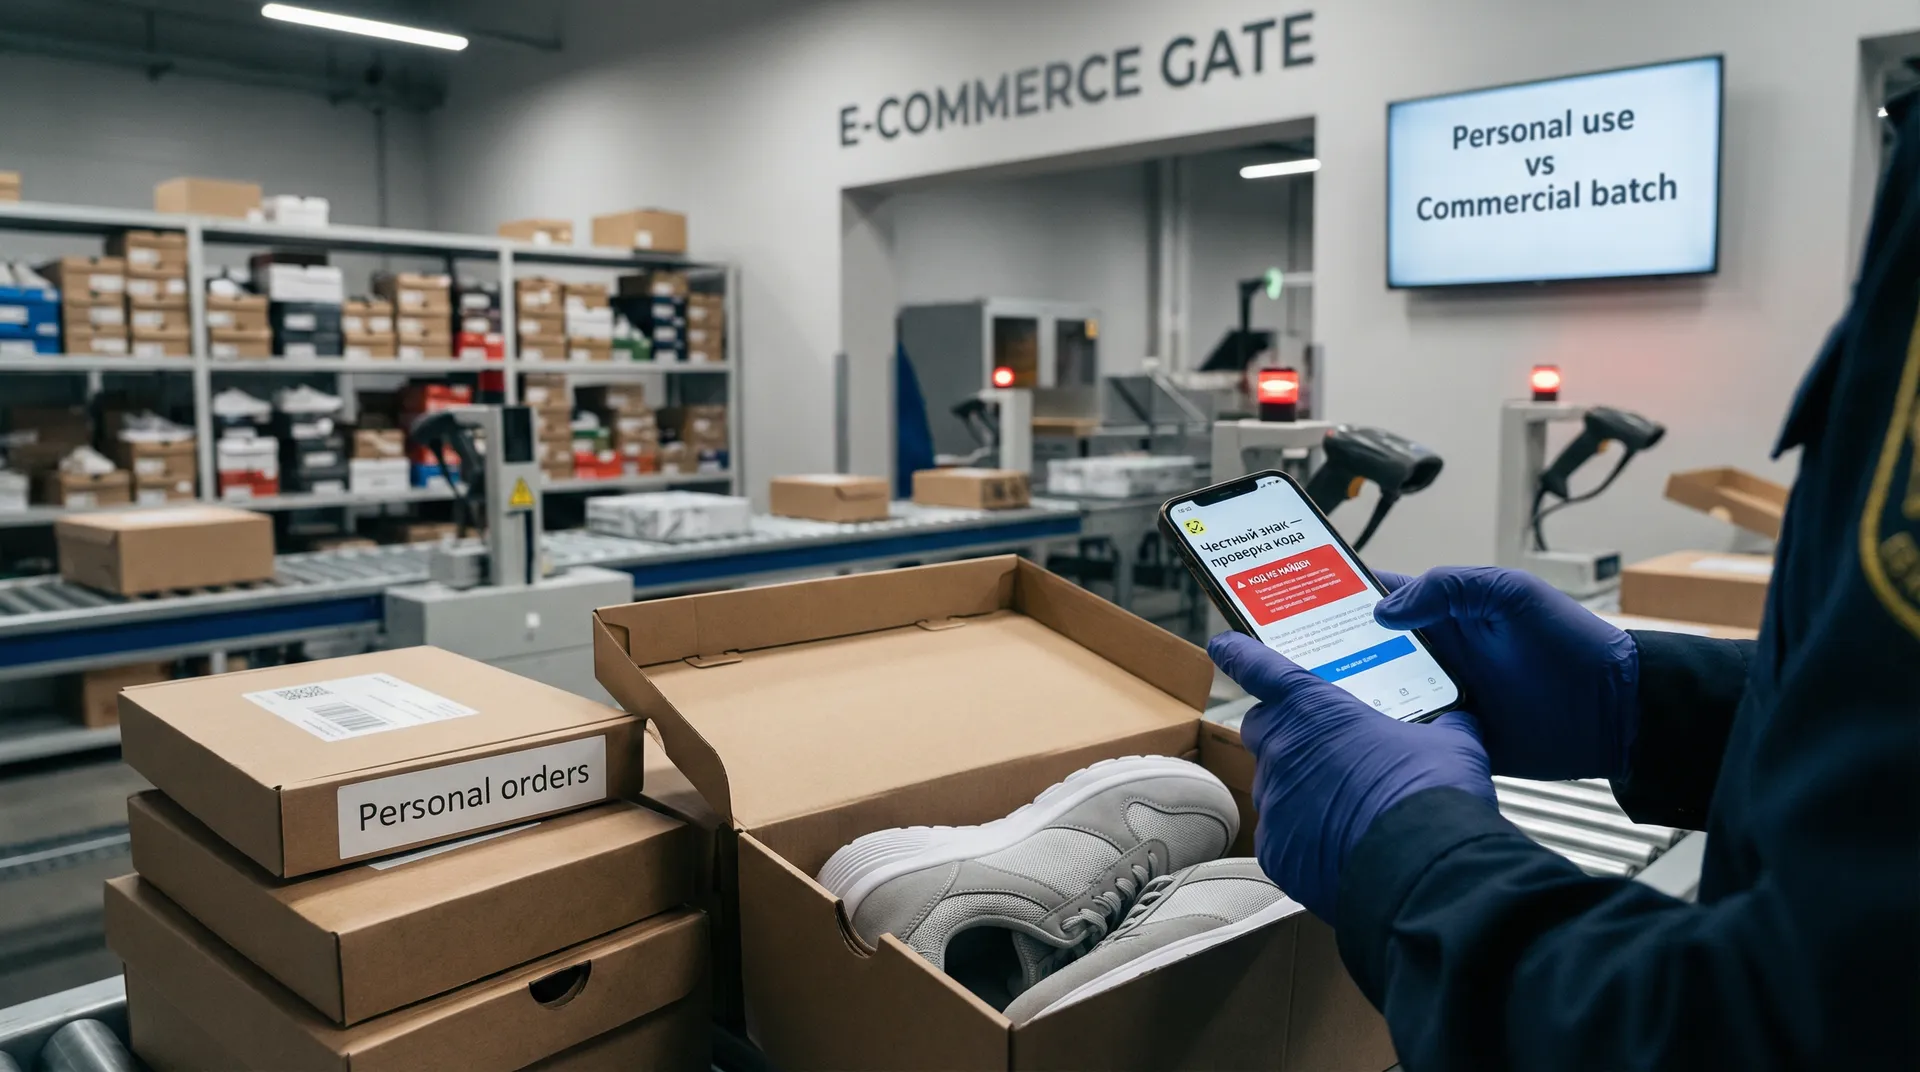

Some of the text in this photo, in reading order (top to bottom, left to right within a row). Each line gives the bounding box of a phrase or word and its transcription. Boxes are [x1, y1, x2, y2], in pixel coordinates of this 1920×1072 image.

[840, 12, 1315, 147] E-COMMERCE GATE
[1453, 108, 1635, 150] Personal use
[1525, 155, 1555, 177] vs
[1416, 172, 1677, 221] Commercial batch
[1200, 528, 1259, 553] Честный
[1259, 520, 1290, 537] знак
[1211, 531, 1305, 568] проверка кода
[1248, 575, 1268, 586] КОД
[359, 763, 589, 831] Personal orders
